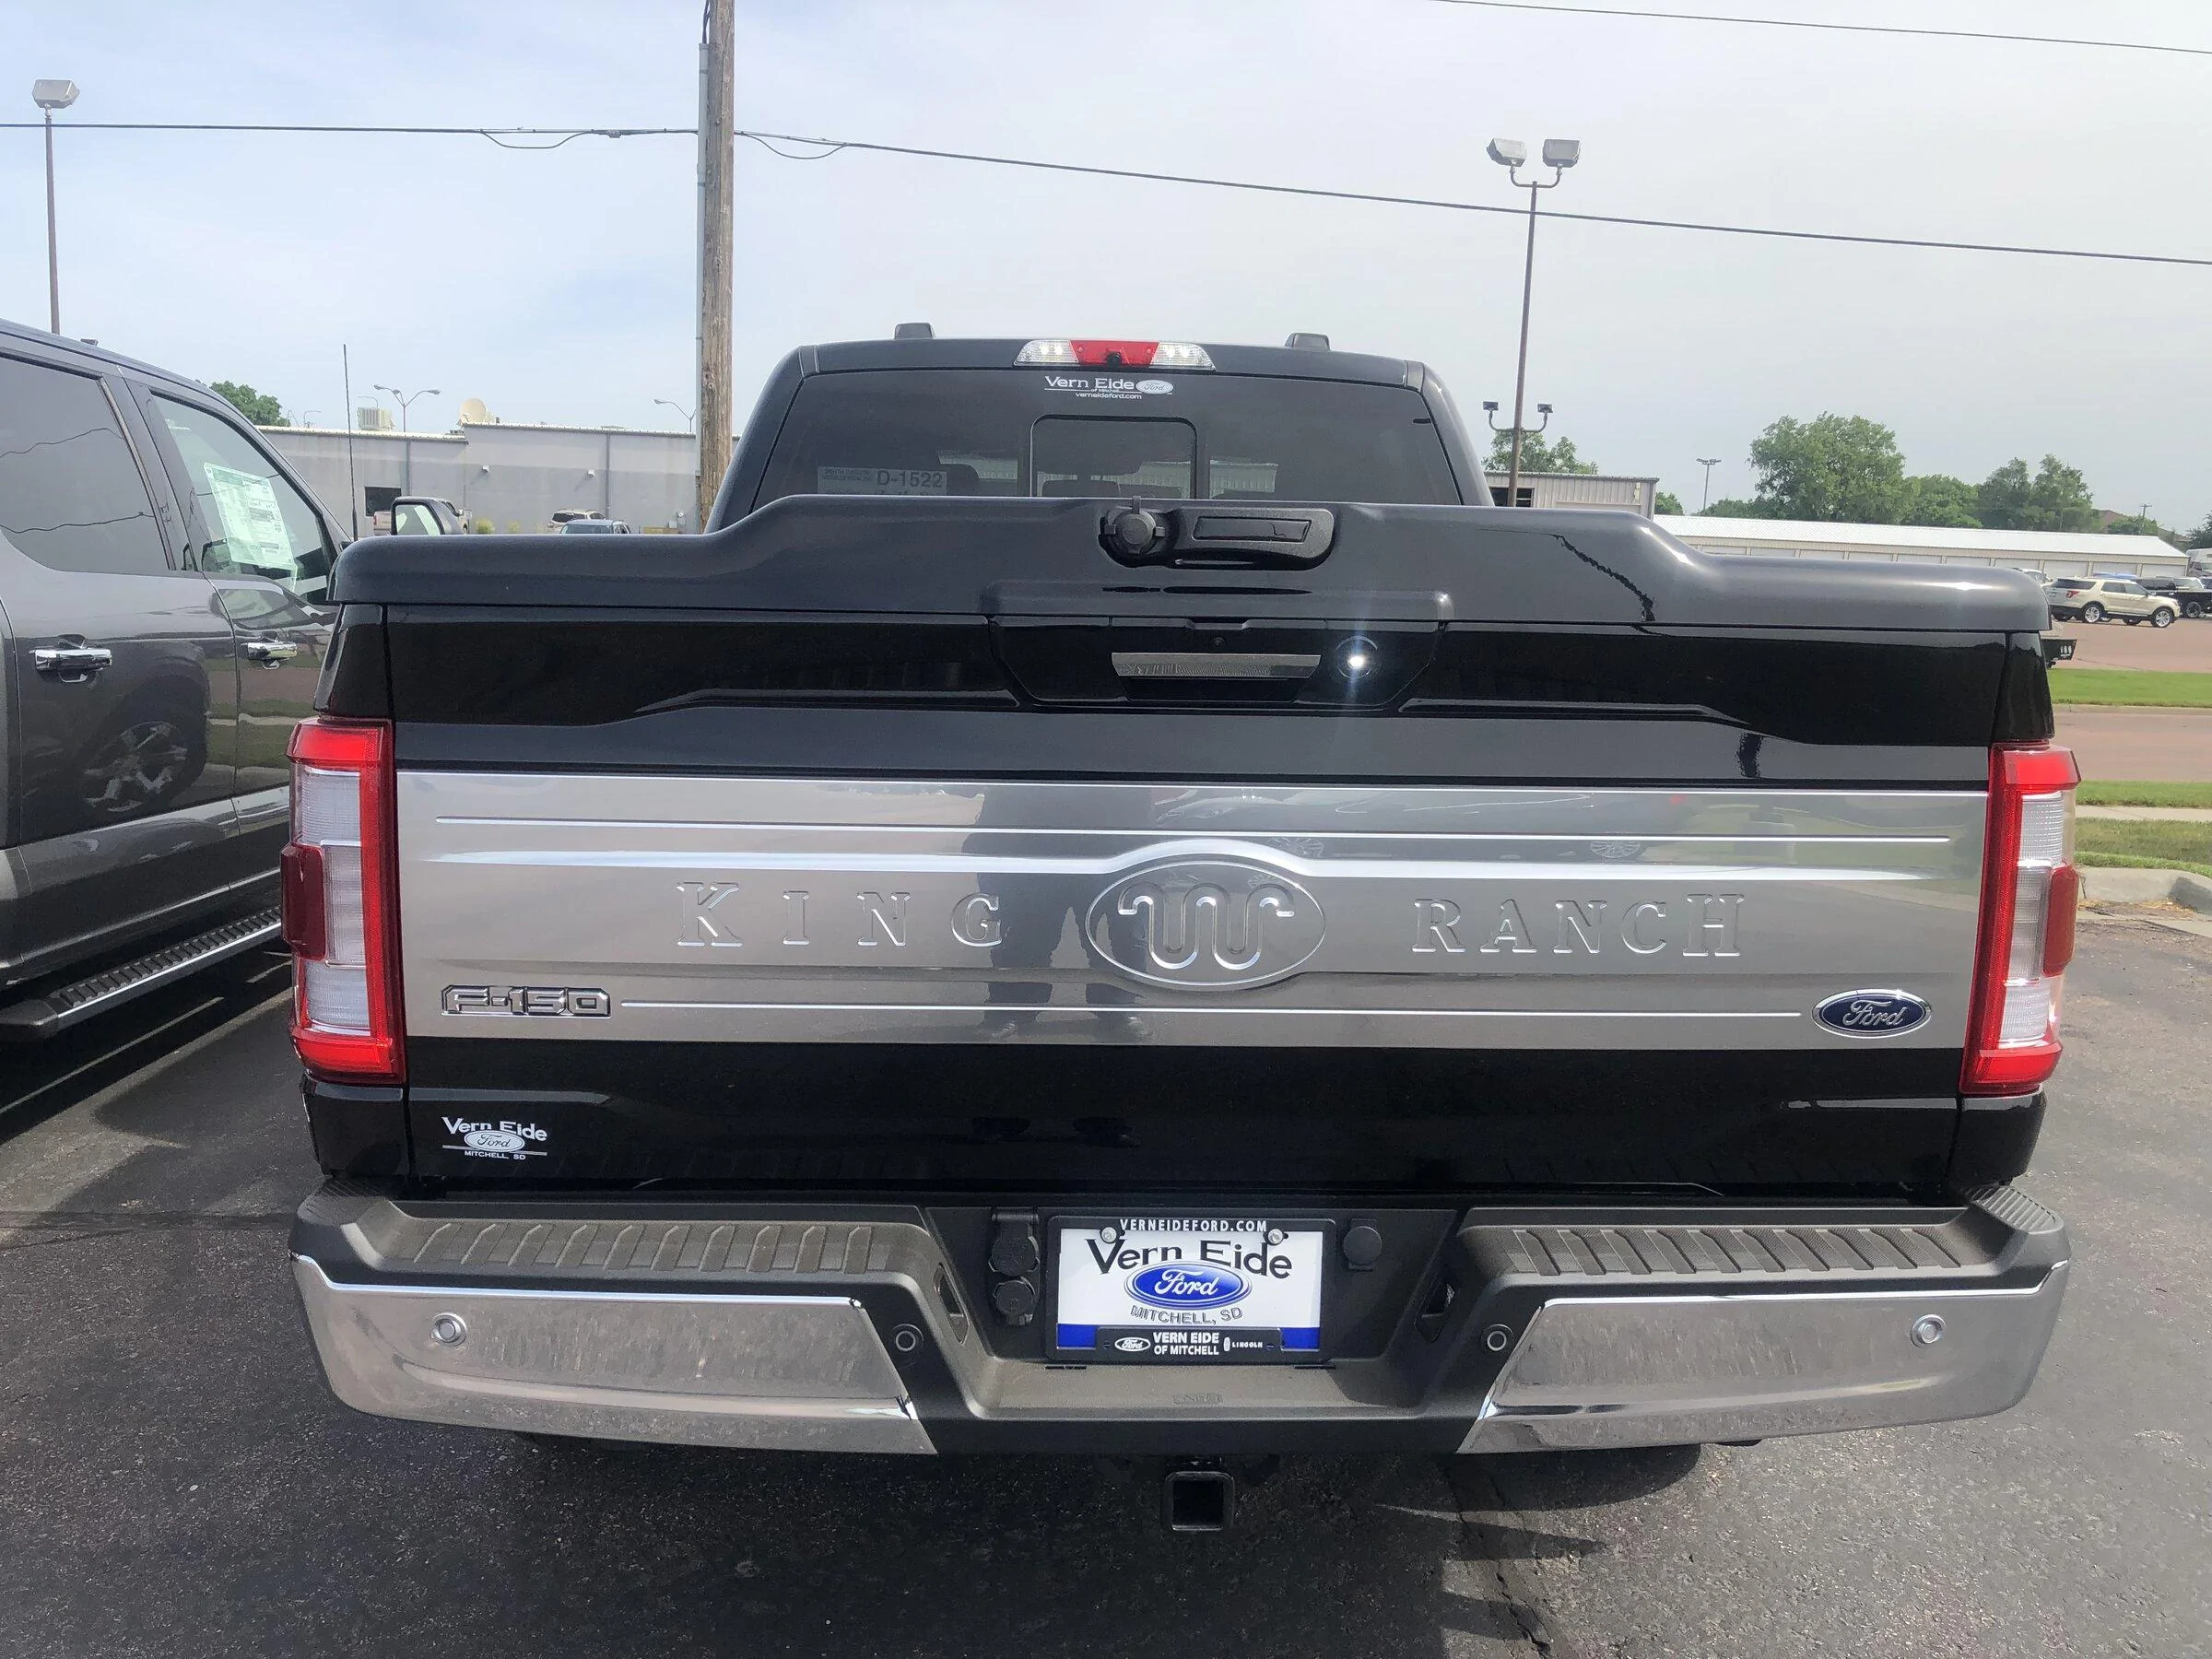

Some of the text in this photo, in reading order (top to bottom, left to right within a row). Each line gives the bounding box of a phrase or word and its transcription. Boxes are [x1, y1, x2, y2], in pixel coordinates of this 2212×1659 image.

[1045, 376, 1089, 388] Vern
[1095, 378, 1135, 389] Eide
[877, 470, 943, 488] D-1522
[677, 881, 1746, 957] KING RANCH
[441, 984, 611, 1018] F-150
[1842, 1000, 1906, 1026] Ford
[441, 1116, 547, 1141] Vern Eide
[477, 1134, 510, 1147] Ford
[1120, 1218, 1266, 1232] VERNEIDEFORD.COM
[1085, 1239, 1292, 1279] Vern Eide
[1154, 1269, 1219, 1296] Ford
[1130, 1304, 1242, 1325] MITCHELL, SD
[1153, 1332, 1219, 1345] VERN EIDE
[1154, 1346, 1219, 1356] OF MITCHELL
